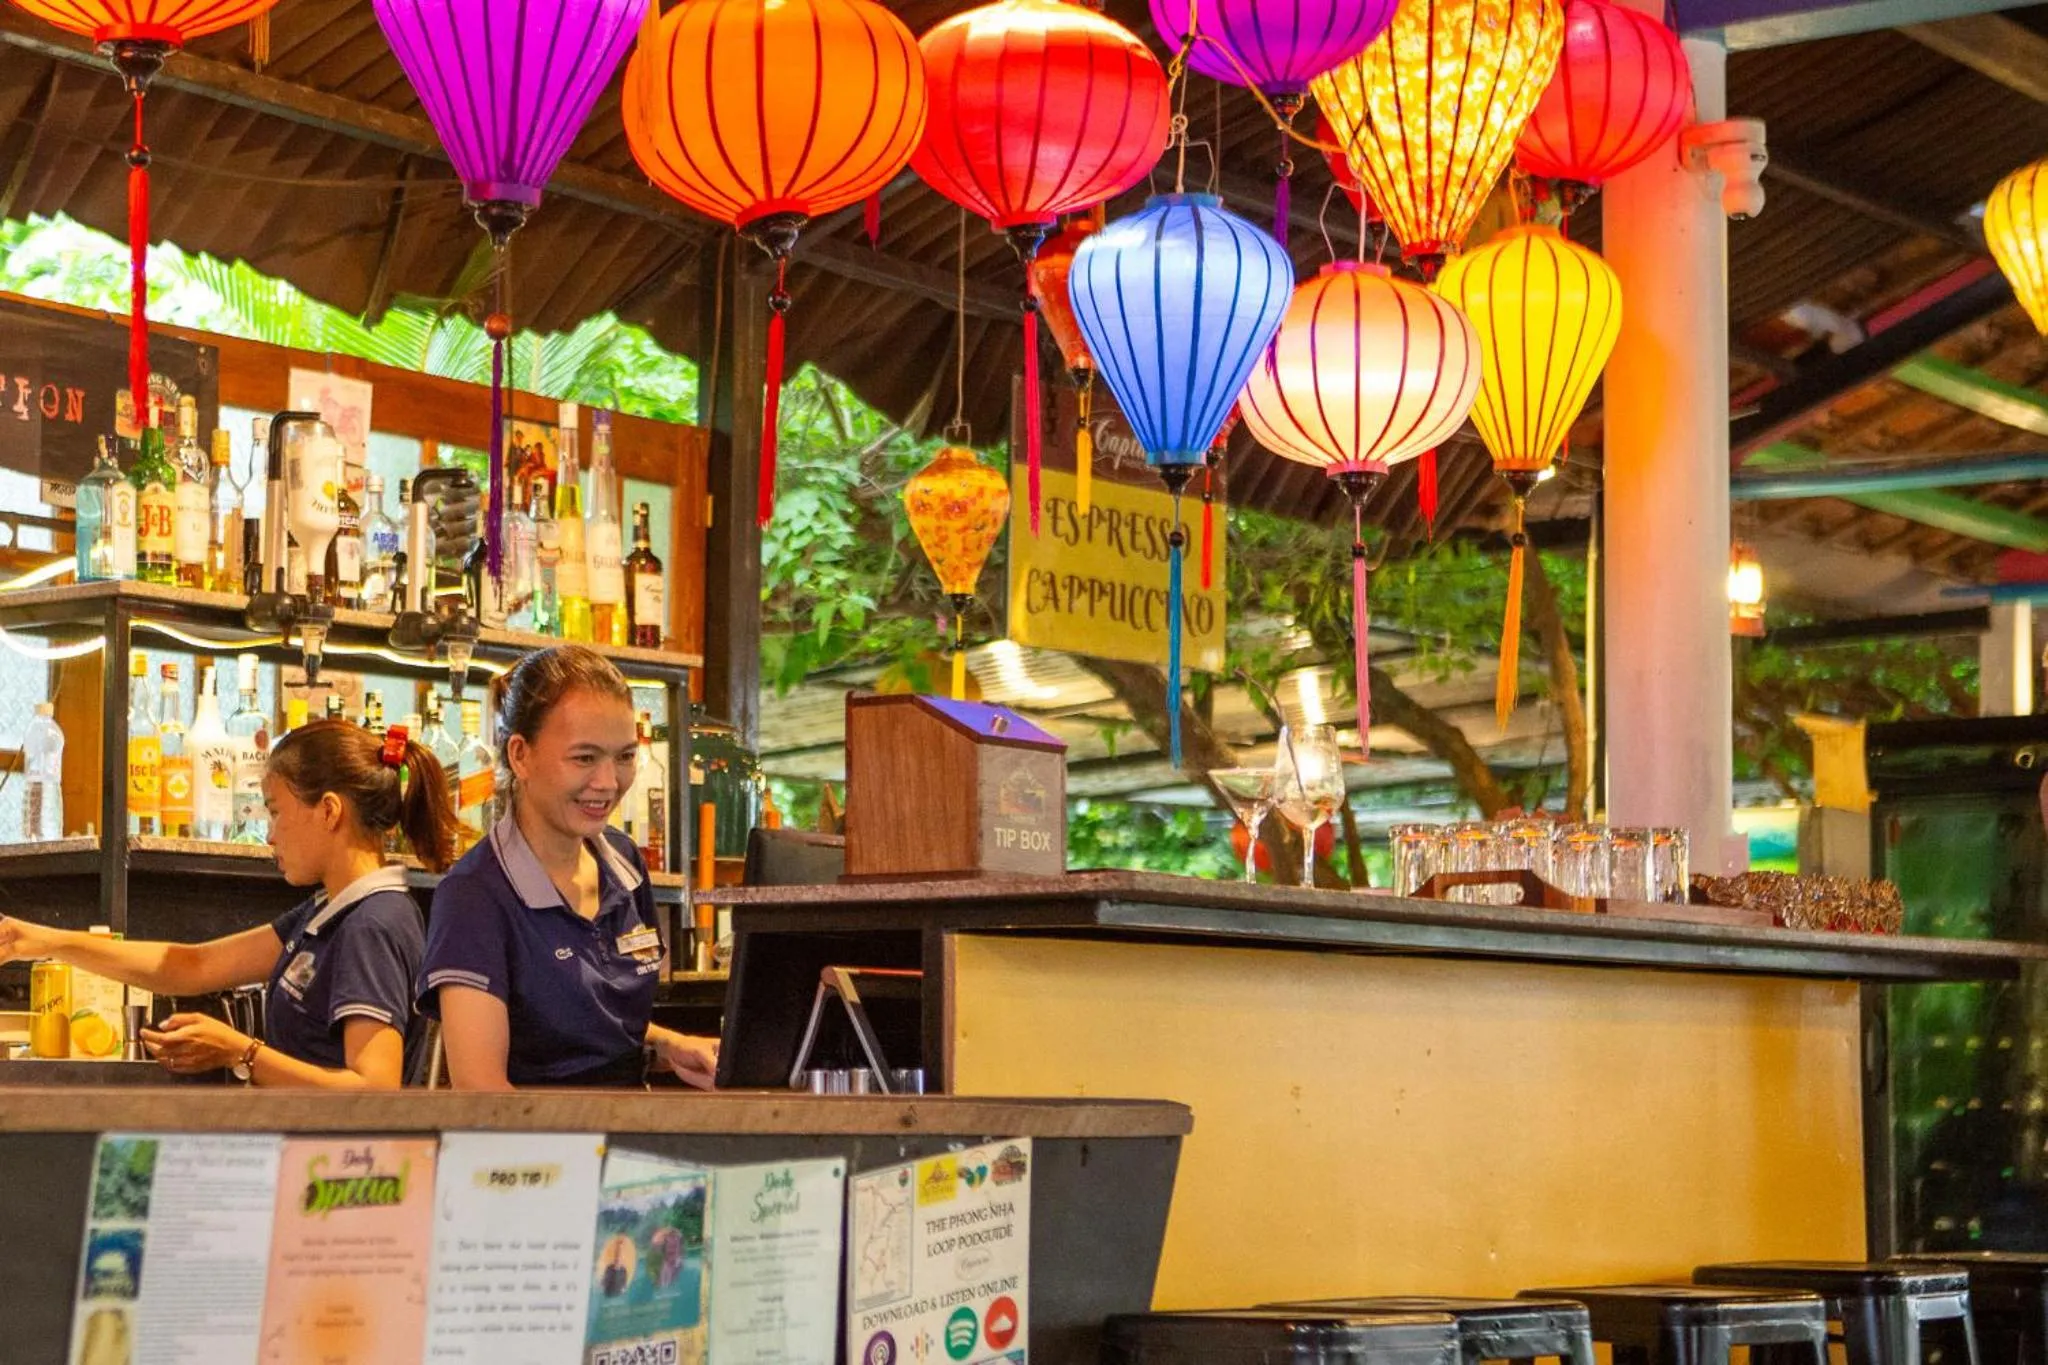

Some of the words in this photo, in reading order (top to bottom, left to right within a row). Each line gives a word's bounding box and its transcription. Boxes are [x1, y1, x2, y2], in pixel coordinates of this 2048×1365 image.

[994, 827, 1017, 849] TIP
[1020, 830, 1052, 852] BOX
[300, 1153, 412, 1220] Special
[488, 1171, 518, 1187] PRO
[926, 1216, 948, 1235] THE
[949, 1207, 989, 1230] PHONG
[988, 1201, 1015, 1221] NHA
[926, 1238, 956, 1259] LOOP
[862, 1299, 929, 1331] DOWNLOAD
[940, 1287, 977, 1306] LISTEN
[977, 1276, 1019, 1298] ONLINE
